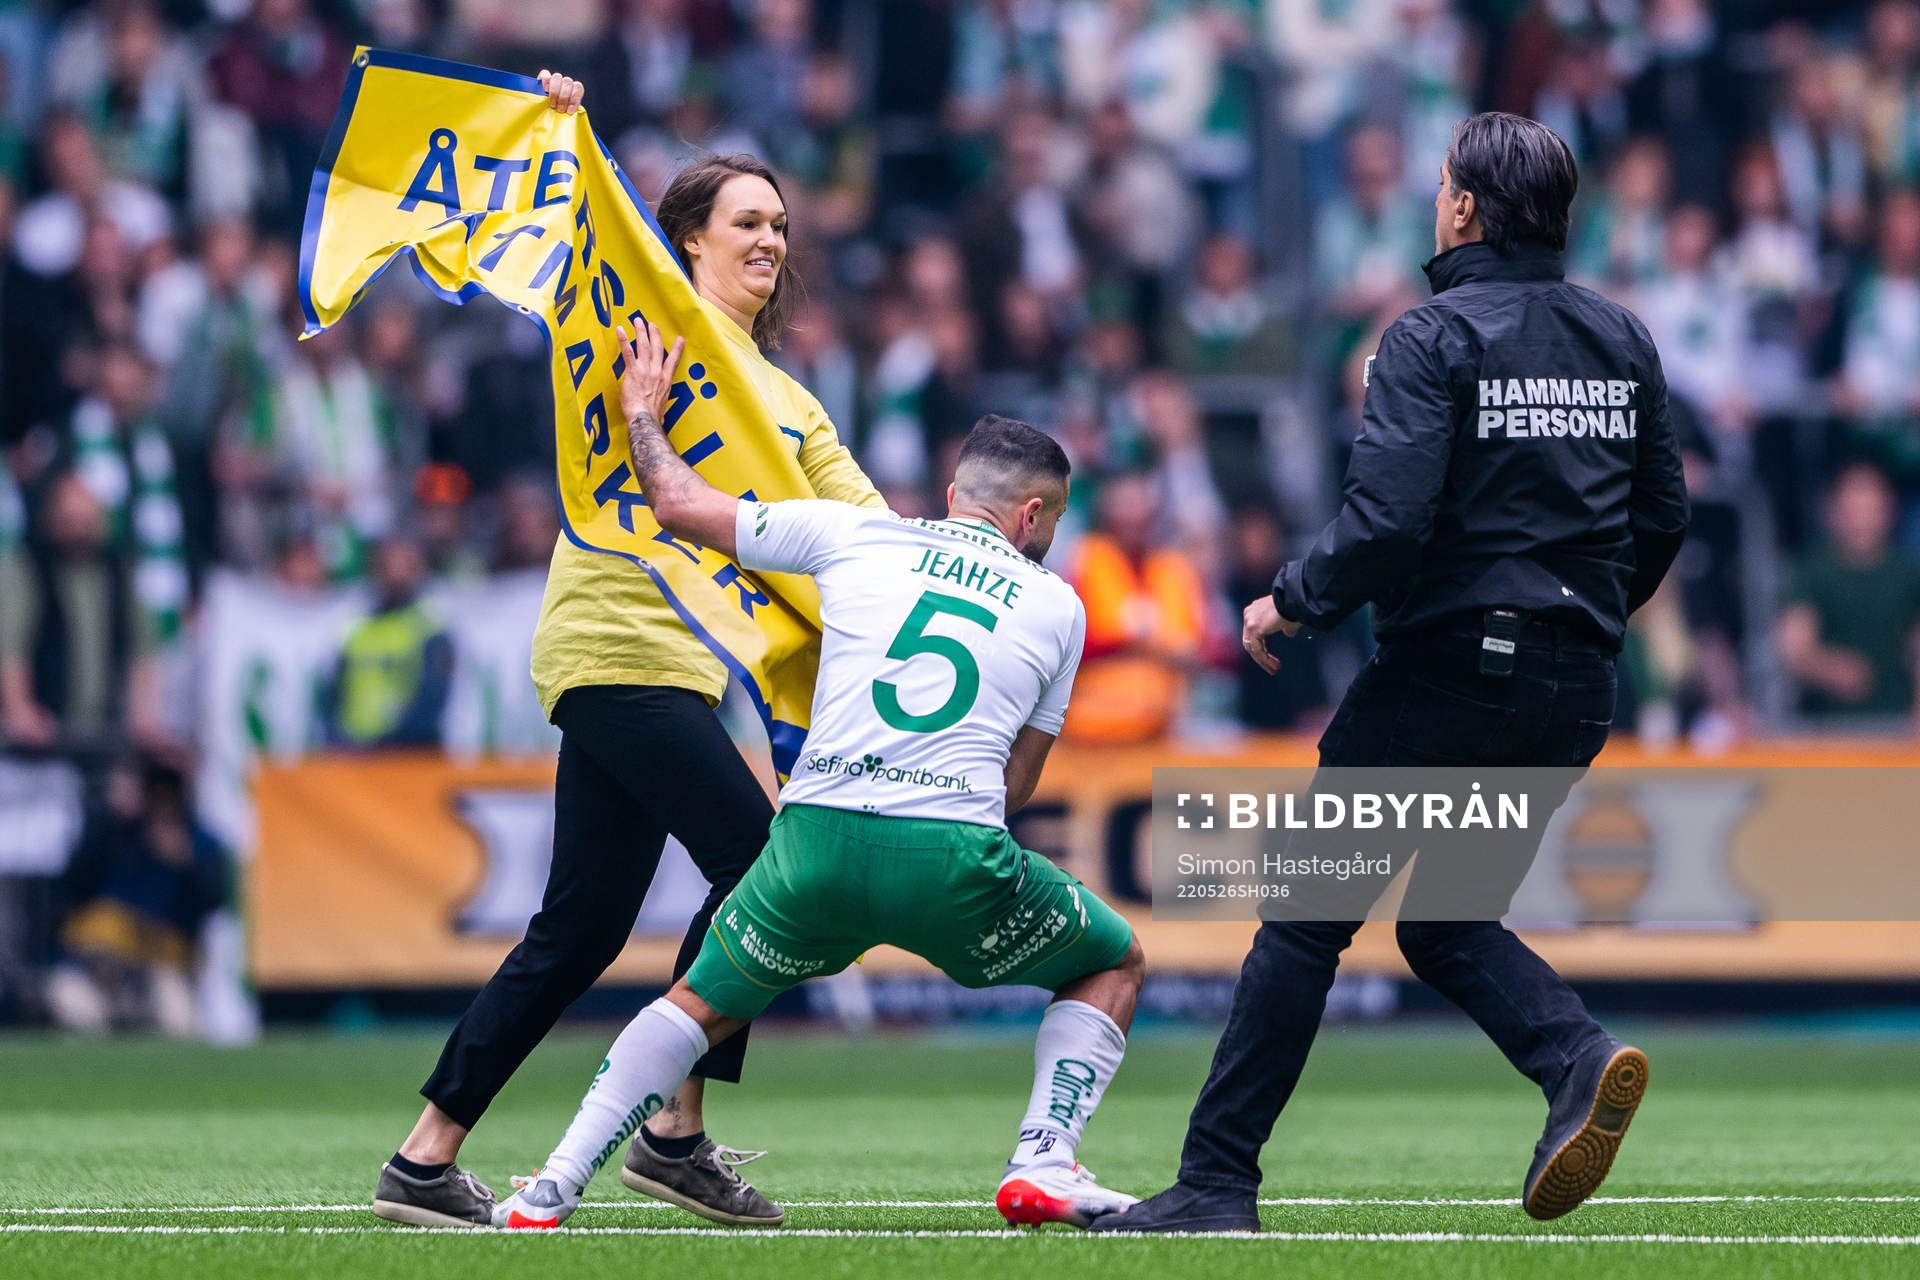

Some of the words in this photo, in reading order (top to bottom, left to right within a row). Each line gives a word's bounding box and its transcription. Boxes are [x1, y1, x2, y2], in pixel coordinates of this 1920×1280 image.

[1477, 409, 1637, 438] PERSONAL
[910, 549, 1022, 609] JEAHZE
[872, 590, 998, 733] 5
[807, 753, 864, 777] Sefina
[871, 767, 973, 794] pantbank
[740, 934, 798, 976] RENOVA
[745, 923, 827, 967] PALLSERVICE
[987, 936, 1051, 981] RENOVA
[1050, 914, 1068, 938] AB
